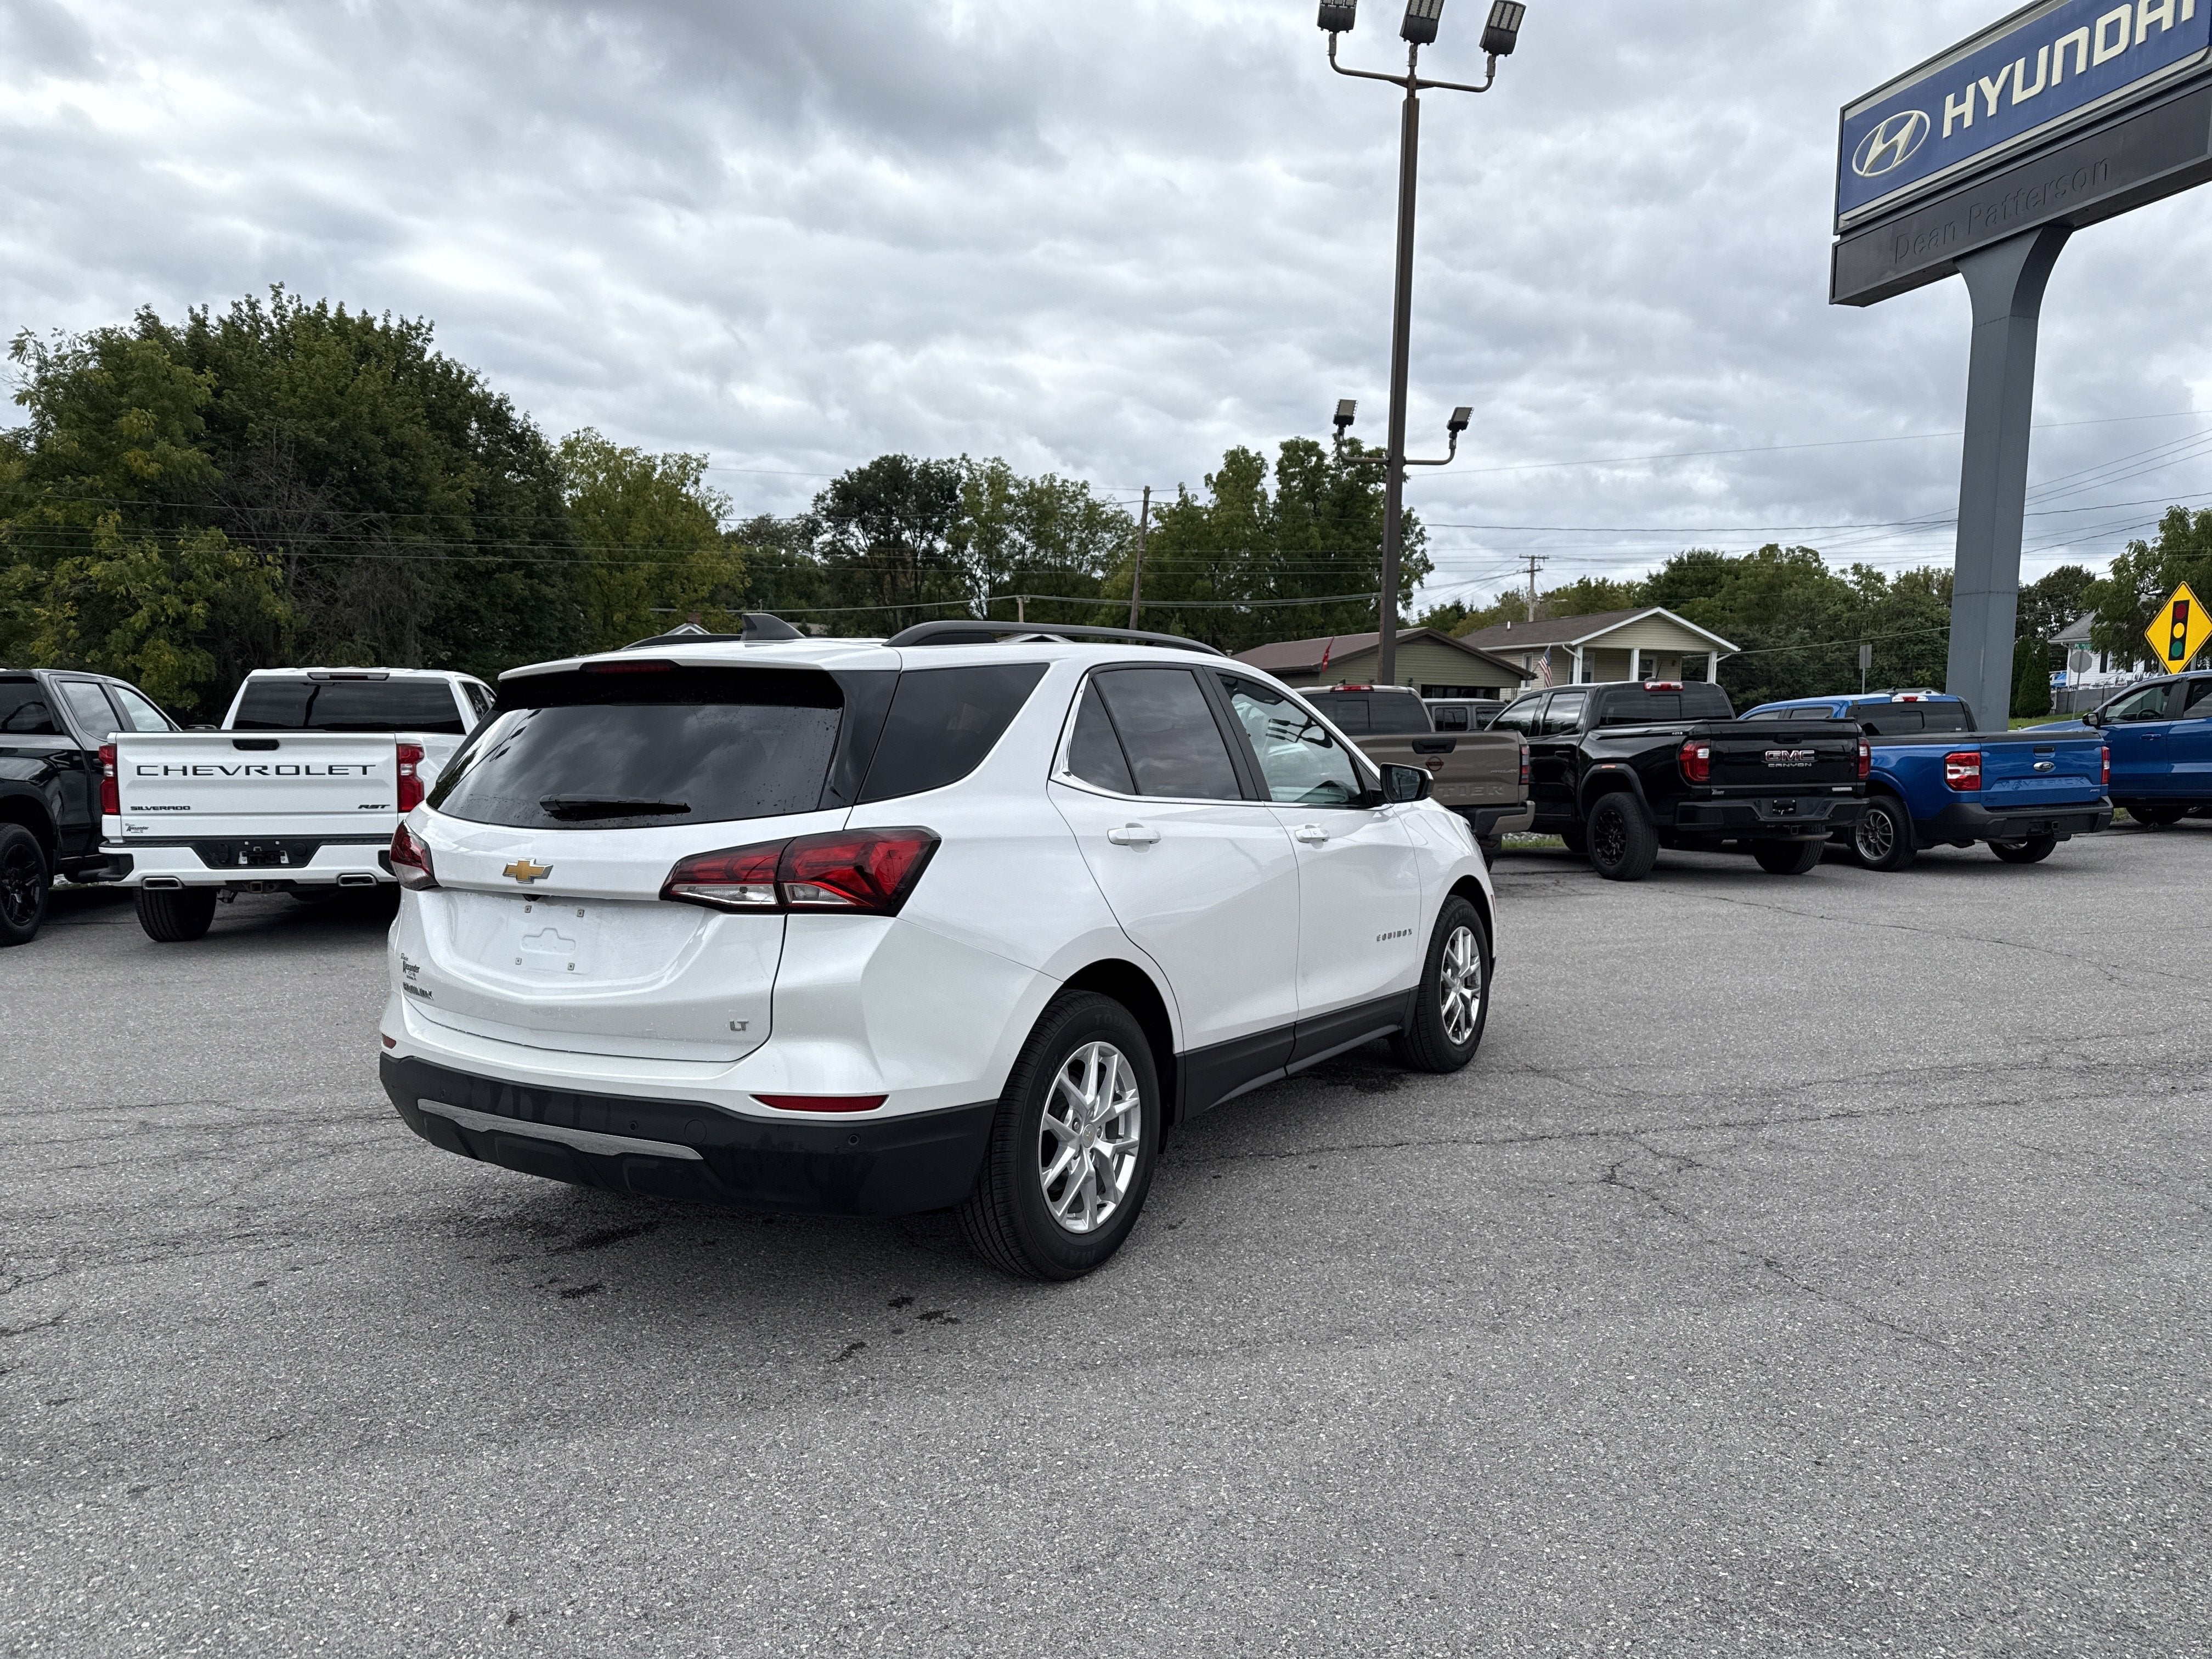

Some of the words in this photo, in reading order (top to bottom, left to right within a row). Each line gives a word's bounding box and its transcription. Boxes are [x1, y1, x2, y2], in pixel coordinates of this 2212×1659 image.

[1895, 221, 1956, 263] Dean
[1968, 157, 2108, 235] Patterson
[1765, 749, 1815, 761] GMC
[136, 764, 376, 776] CHEVROLET
[1996, 777, 2085, 787] MAVERICK
[1376, 928, 1413, 942] EQUINOX
[729, 1020, 749, 1031] LT
